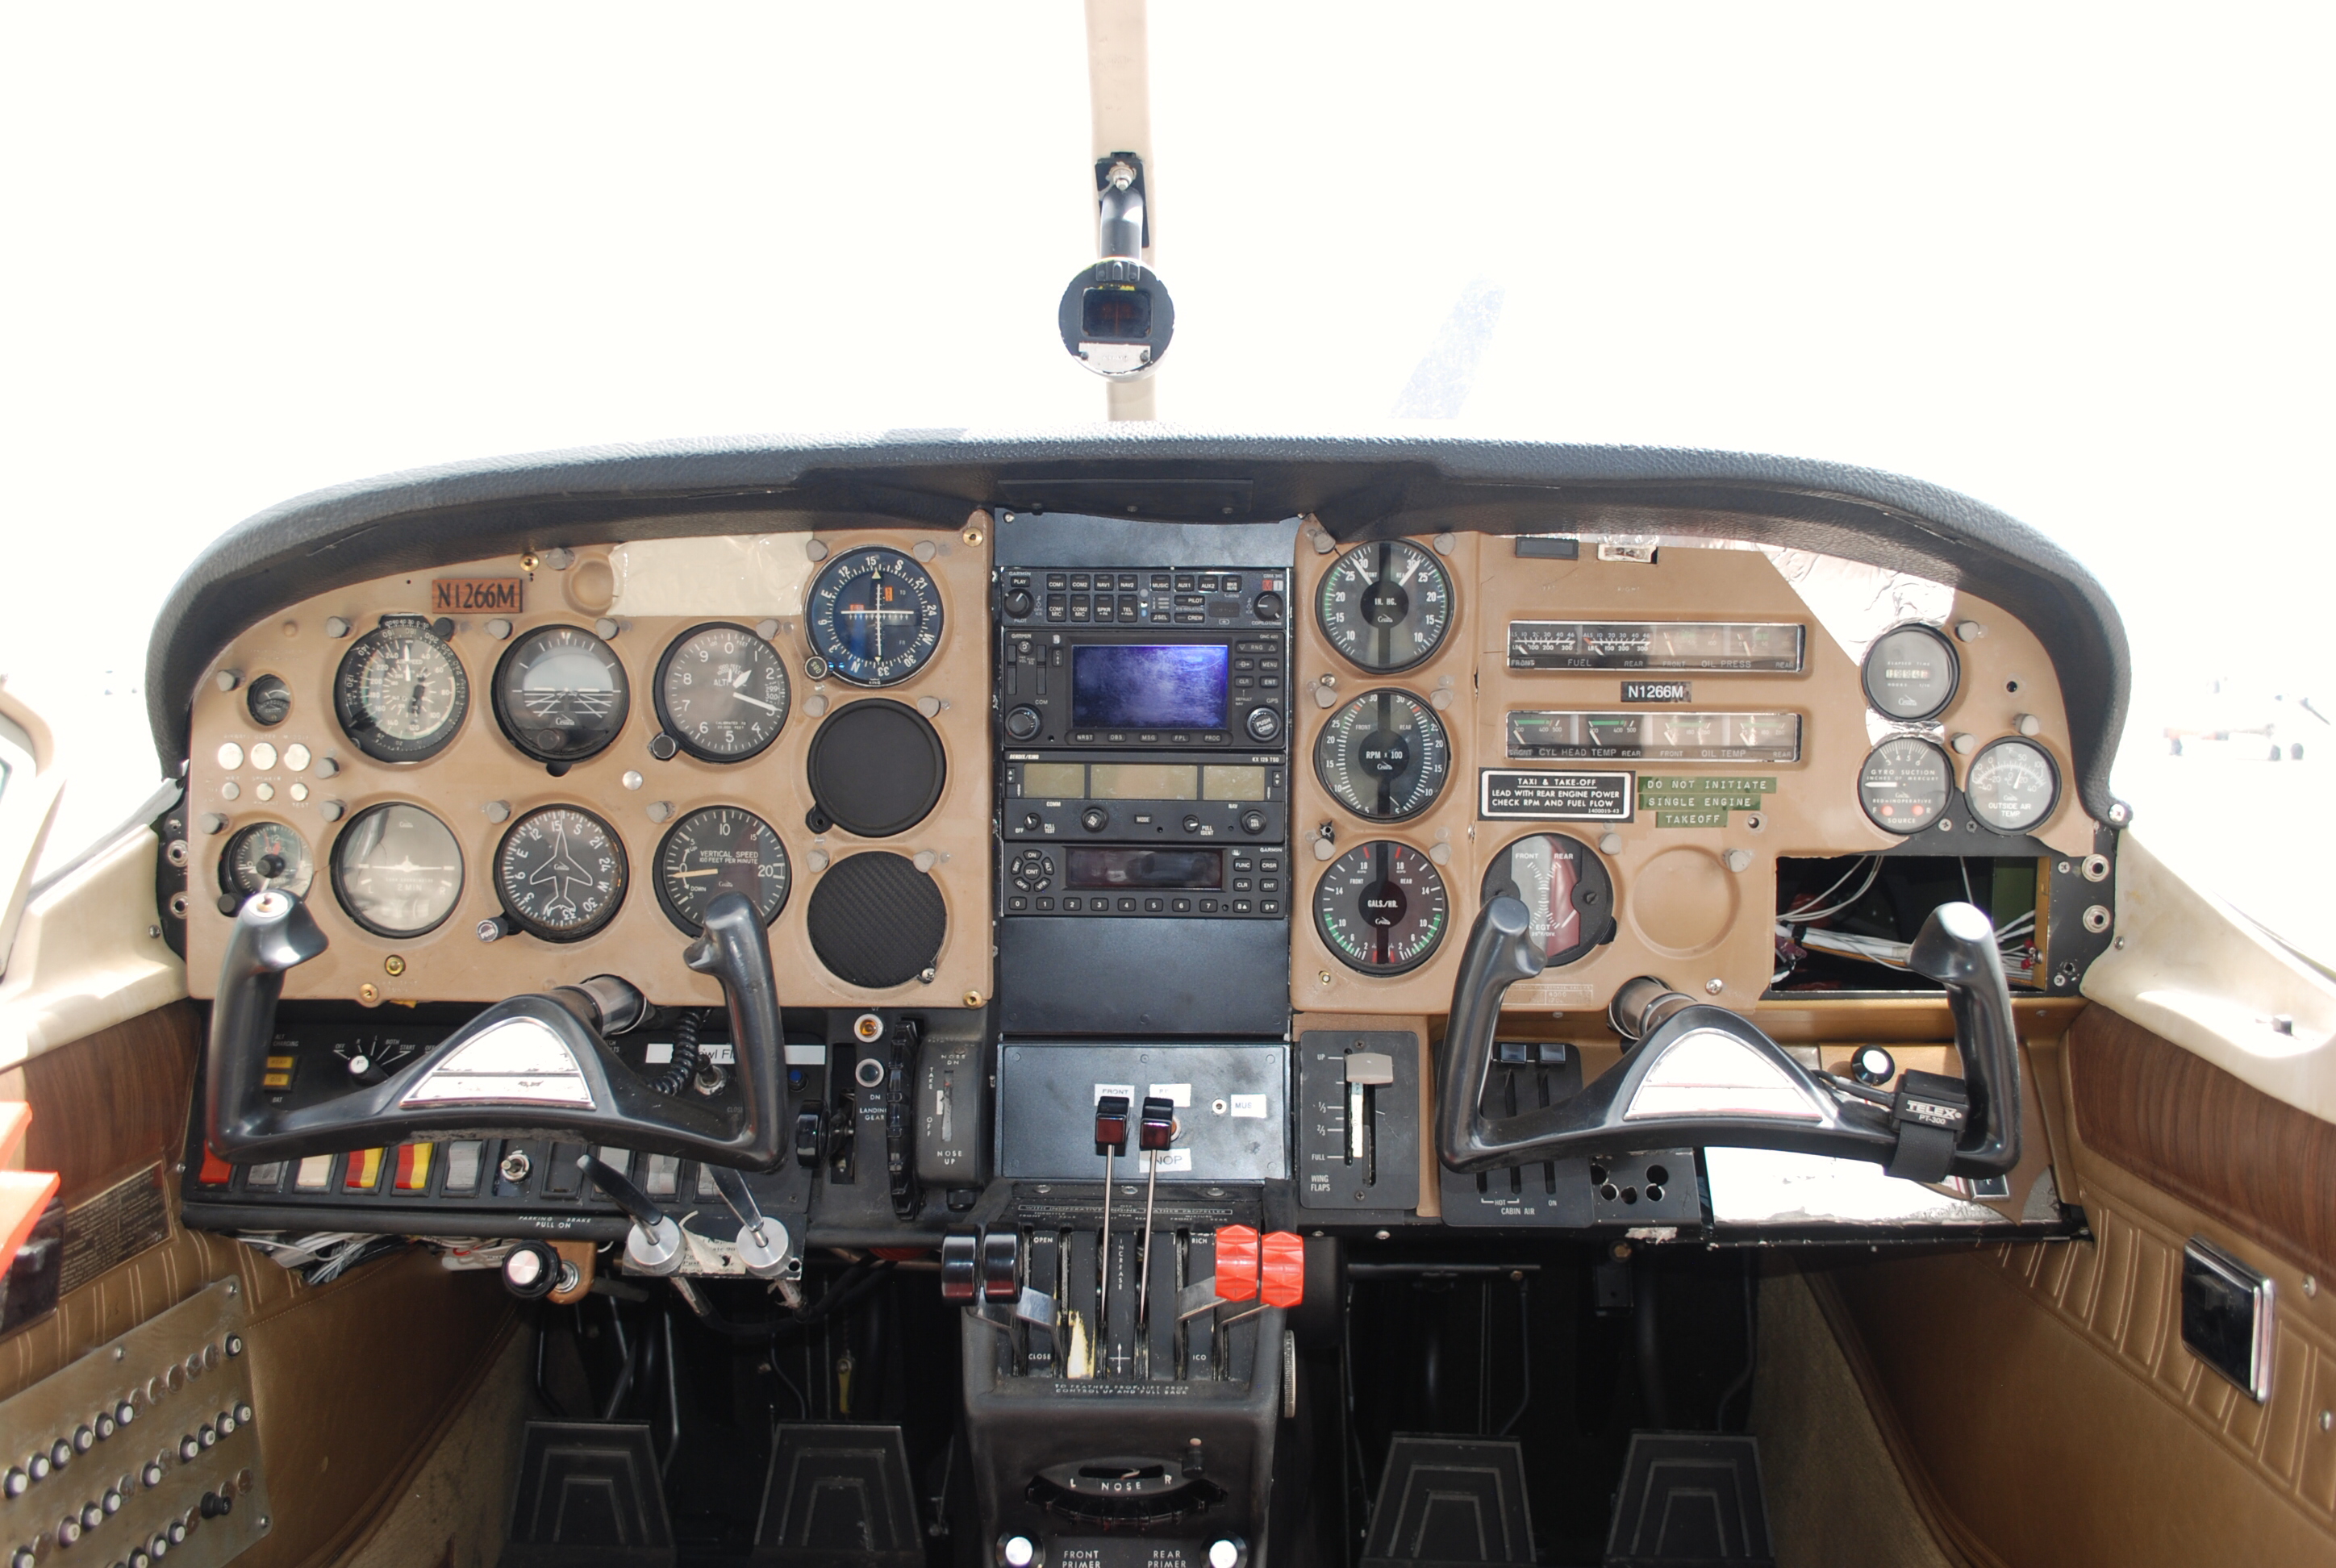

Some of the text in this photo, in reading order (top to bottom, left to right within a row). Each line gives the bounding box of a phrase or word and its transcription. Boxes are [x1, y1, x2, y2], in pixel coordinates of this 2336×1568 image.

[866, 557, 877, 565] 15
[838, 566, 851, 578] 12
[1345, 571, 1355, 581] 25
[1419, 573, 1428, 582] 25
[437, 582, 515, 608] N1266M
[1336, 592, 1345, 602] 20
[1426, 592, 1437, 602] 20
[1336, 612, 1345, 622] 15
[1426, 615, 1434, 624] 15
[1346, 631, 1355, 640] 10
[1414, 632, 1423, 642] 10
[700, 651, 708, 662] 9
[683, 673, 692, 685] 8
[1628, 685, 1683, 699] N1266M
[1434, 765, 1442, 773] 15
[1647, 780, 1767, 789] DO NOT INITIATE
[1649, 798, 1750, 807] SINGLE ENGINE
[1666, 815, 1720, 824] TAKEOFF
[530, 828, 542, 840] 12
[720, 824, 730, 835] 10
[516, 849, 528, 858] E
[758, 865, 774, 877] 20
[1339, 919, 1346, 927] 10
[1907, 1100, 1957, 1120] TELEX
[1919, 1115, 1946, 1124] PT-300
[1311, 1184, 1330, 1192] FLAPS
[1102, 1482, 1141, 1491] NOSE
[1064, 1550, 1099, 1558] FRONT
[1153, 1550, 1181, 1558] REAR
[1147, 1560, 1187, 1568] PRIMER
